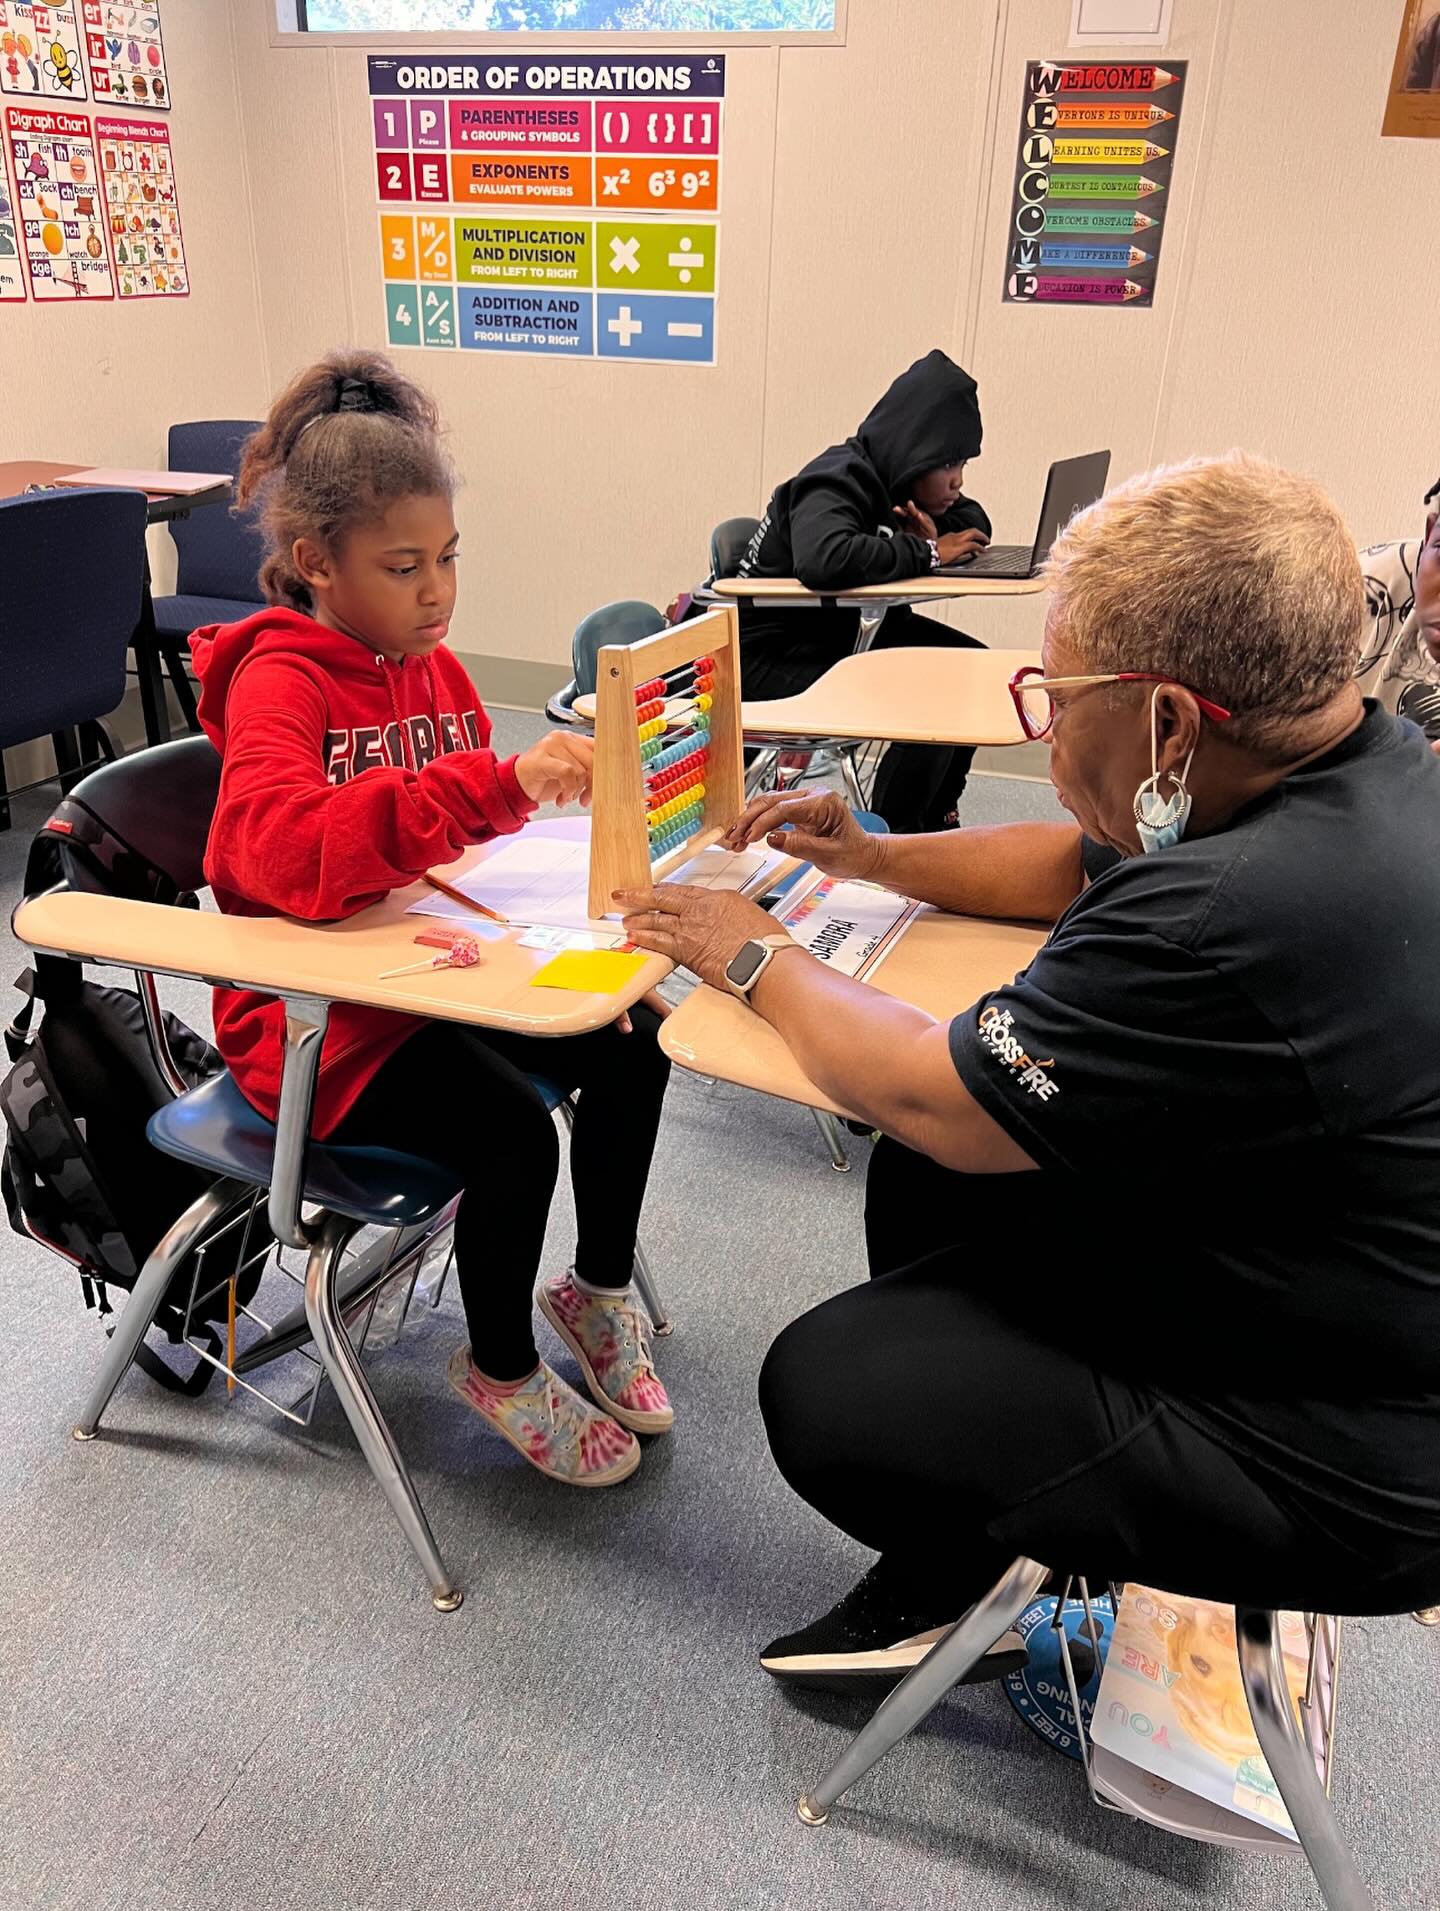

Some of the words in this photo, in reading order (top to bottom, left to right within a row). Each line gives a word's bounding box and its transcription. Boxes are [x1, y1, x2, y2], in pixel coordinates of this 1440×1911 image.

[14, 4, 33, 18] kiss
[56, 11, 74, 24] buzz
[84, 3, 100, 21] er
[89, 35, 103, 57] ir
[92, 71, 108, 89] ur
[397, 66, 479, 89] ORDER
[486, 67, 520, 89] OF
[525, 66, 691, 90] OPERATIONS
[1032, 66, 1155, 93] WELCOME
[9, 110, 55, 132] Digraph
[57, 116, 88, 132] Chart
[419, 110, 437, 134] P
[461, 110, 579, 125] PARENTHESES
[1109, 111, 1121, 120] IS
[97, 123, 128, 136] Beginning
[128, 125, 149, 136] Blends
[149, 127, 168, 138] Chart
[384, 112, 395, 136] 1
[461, 130, 468, 141] &
[471, 130, 526, 142] GROUPING
[528, 132, 580, 143] SYMBOLS
[15, 142, 28, 158] sh
[38, 144, 52, 153] fish
[56, 144, 68, 161] th
[72, 147, 92, 157] tooth
[1104, 146, 1142, 156] UNITES
[386, 165, 402, 189] 2
[422, 164, 440, 188] E
[472, 164, 569, 180] EXPONENTS
[20, 182, 34, 198] ck
[61, 185, 74, 199] ch
[74, 186, 97, 194] bench
[469, 184, 524, 195] EVALUATE
[526, 185, 574, 196] POWERS
[1090, 181, 1099, 190] IS
[25, 222, 40, 237] ge
[65, 224, 80, 237] tch
[462, 228, 585, 245] MULTIPLICATION
[391, 238, 405, 260] 3
[472, 247, 504, 260] AND
[509, 249, 576, 263] DIVISION
[1063, 250, 1071, 258] A
[31, 261, 50, 276] dge
[81, 261, 108, 273] bridge
[471, 265, 500, 275] FROM
[503, 266, 526, 277] LEFT
[530, 267, 544, 277] TO
[546, 268, 579, 279] RIGHT
[1089, 284, 1102, 294] IS
[472, 296, 542, 311] ADDITION
[547, 300, 580, 313] AND
[395, 304, 412, 326] 4
[475, 314, 577, 330] SUBTRACTION
[474, 331, 502, 342] FROM
[505, 332, 530, 343] LEFT
[532, 334, 545, 344] TO
[548, 335, 580, 346] RIGHT
[1000, 1009, 1015, 1028] THE
[978, 1027, 1036, 1094] MOVEMENT
[979, 1006, 1060, 1102] CROSSFIRE
[1022, 1606, 1046, 1630] FEET
[1136, 1597, 1178, 1631] SO
[1122, 1647, 1182, 1689] ARE
[1028, 1712, 1061, 1740] FEET
[1108, 1702, 1172, 1750] YOU
[1059, 1735, 1071, 1747] 6
